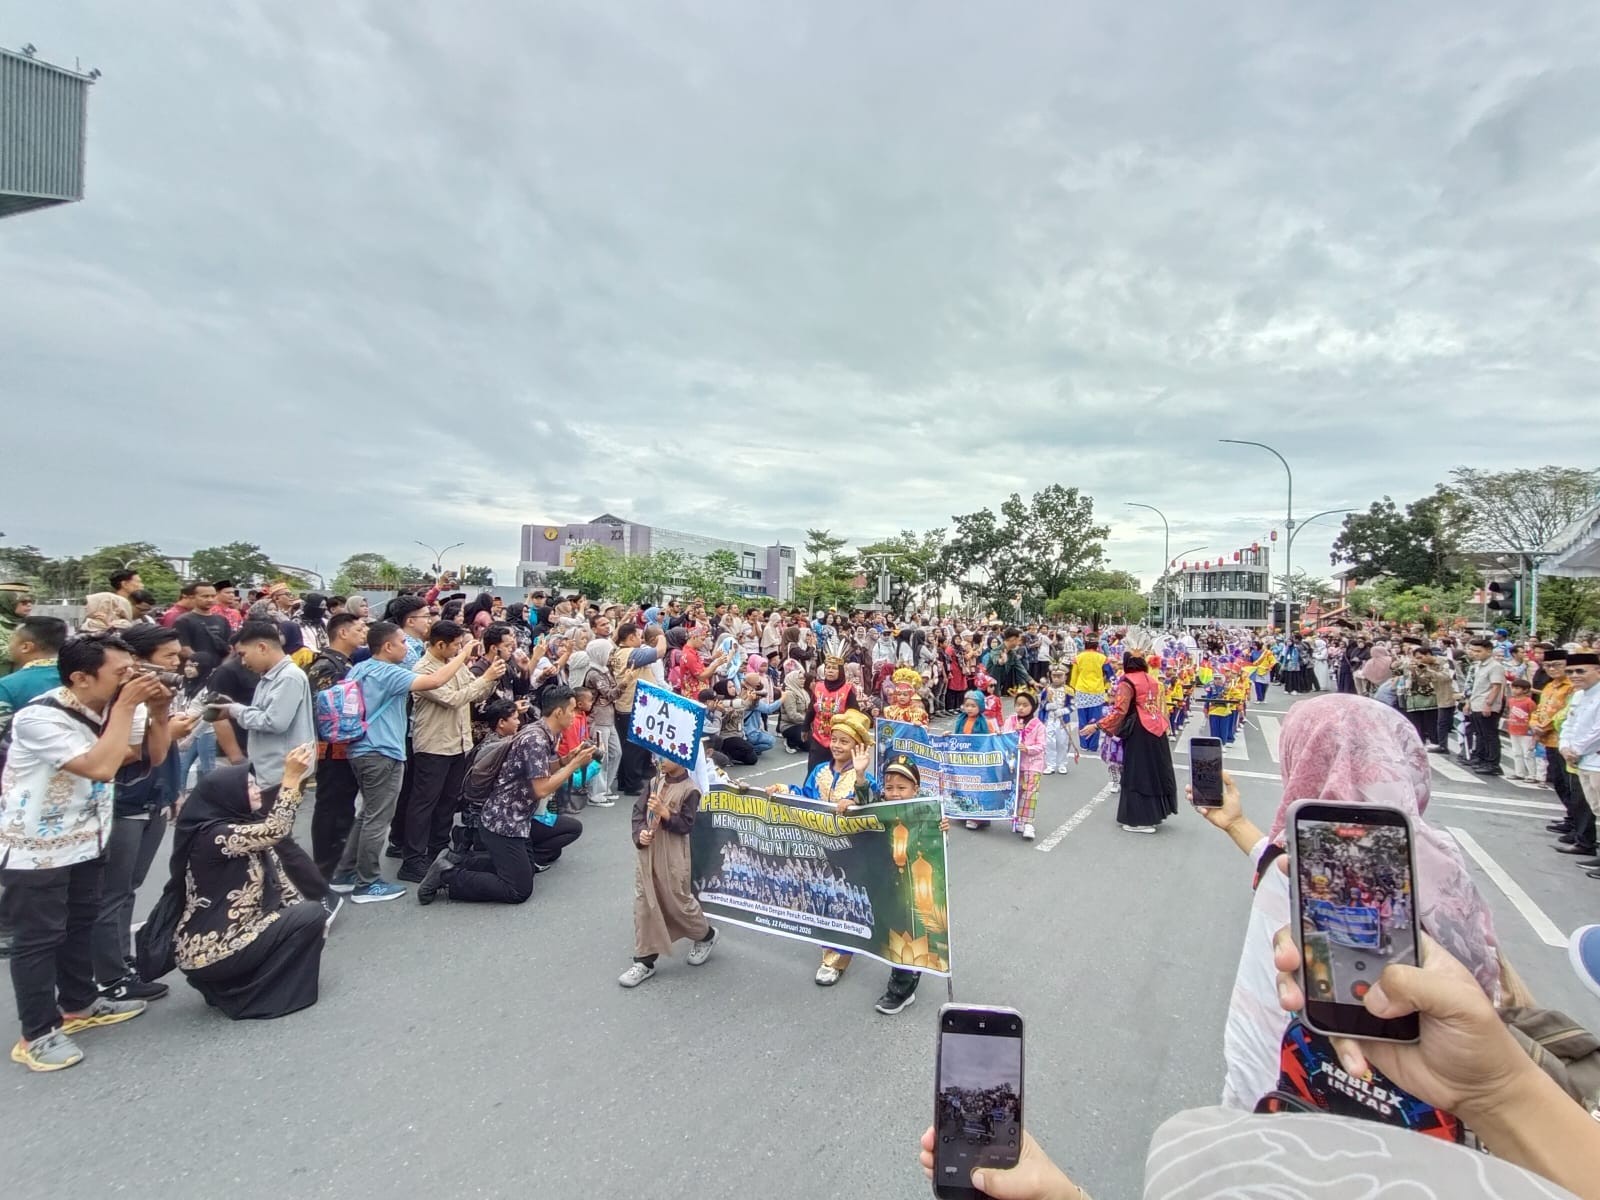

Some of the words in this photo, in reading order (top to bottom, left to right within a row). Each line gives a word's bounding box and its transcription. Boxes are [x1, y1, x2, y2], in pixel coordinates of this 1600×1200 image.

[658, 701, 669, 719] A
[646, 715, 676, 740] 015
[713, 814, 755, 832] MENGIKUTI
[769, 827, 801, 841] TARHIB
[802, 830, 850, 849] RAMADHAN
[769, 803, 838, 835] PALANGKA
[836, 815, 885, 835] RAYA
[759, 840, 774, 855] 1447
[776, 842, 784, 856] H
[792, 843, 817, 857] 2026
[769, 906, 786, 917] Dengan
[816, 917, 831, 927] Sabar
[831, 920, 843, 929] Dan
[771, 919, 779, 927] 12
[779, 921, 799, 932] Februari
[799, 926, 812, 935] 2026
[1321, 1061, 1404, 1109] ROBLOX
[1327, 1077, 1393, 1115] IRSYAD
